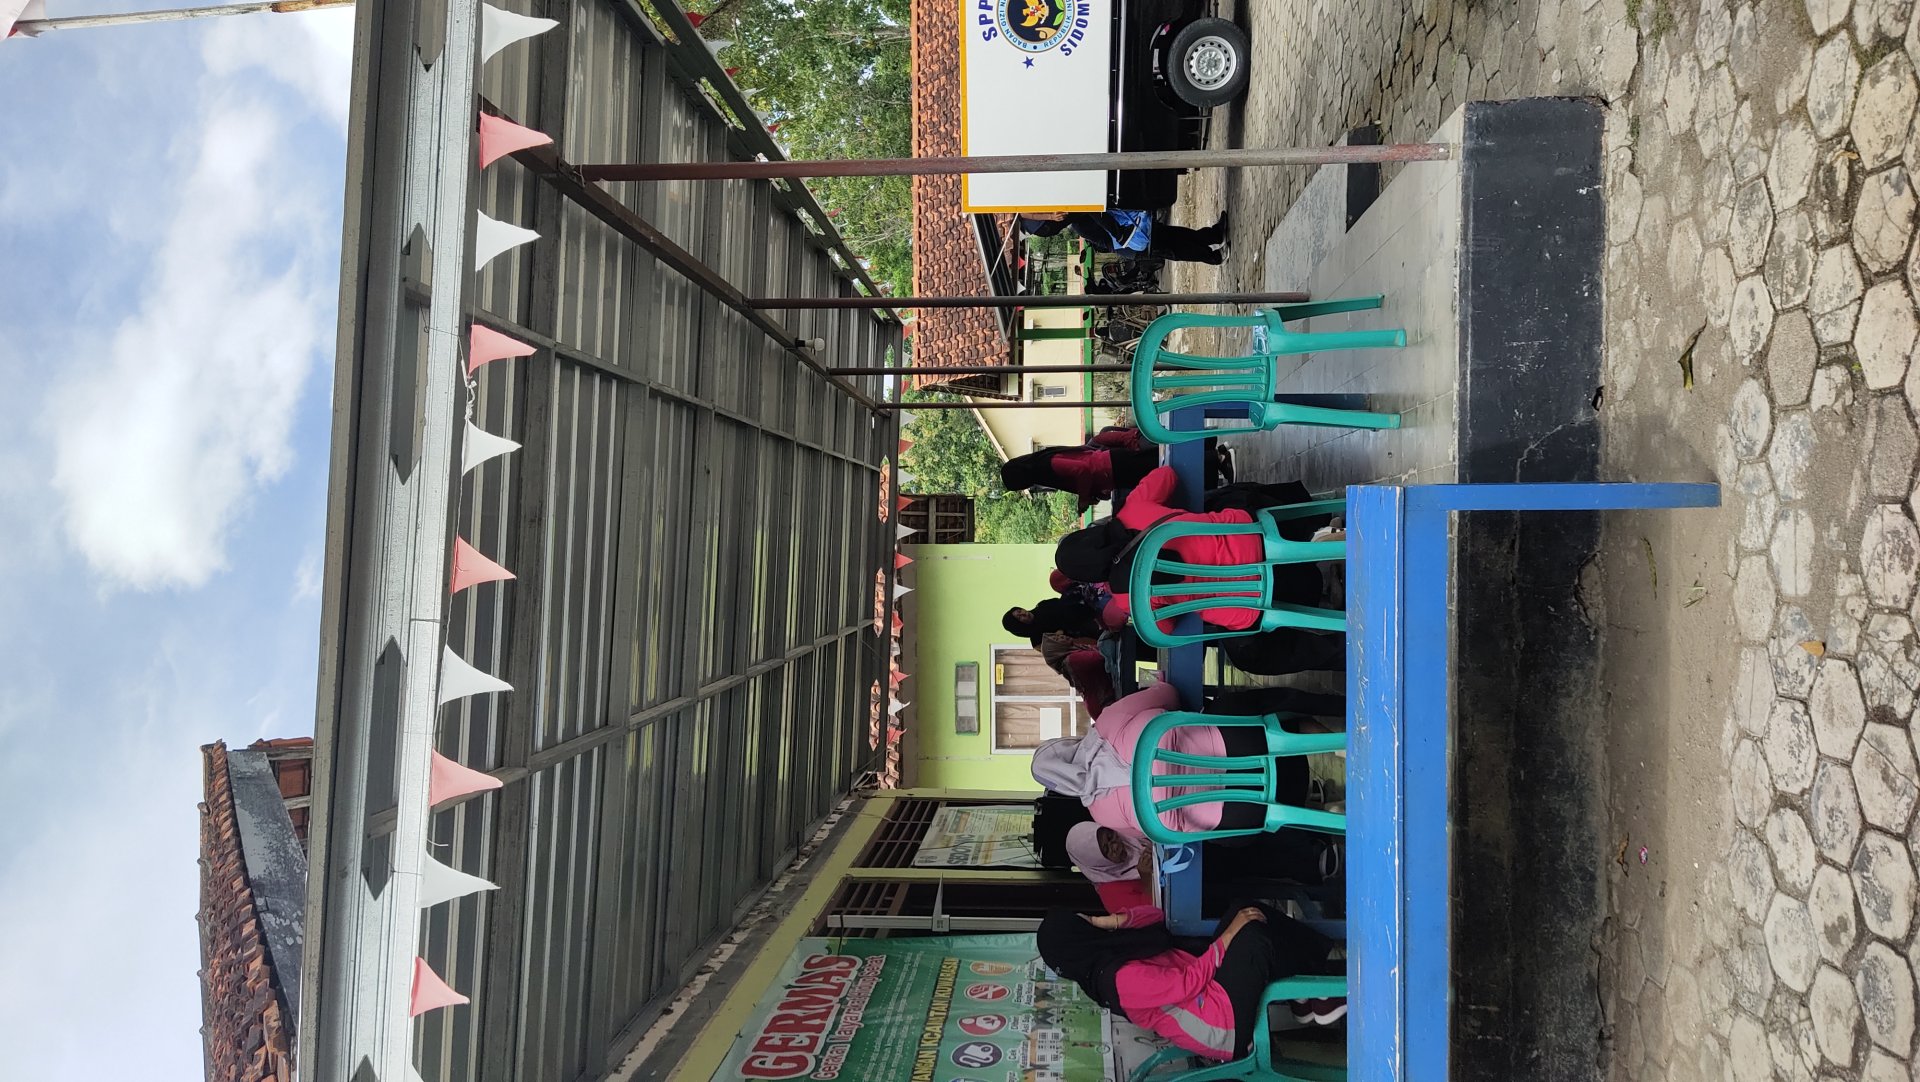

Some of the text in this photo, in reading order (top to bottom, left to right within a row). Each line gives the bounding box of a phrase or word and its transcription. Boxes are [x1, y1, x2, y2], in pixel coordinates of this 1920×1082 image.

[999, 10, 1007, 26] GIZI
[1043, 15, 1072, 48] REPUBLIK
[1004, 28, 1028, 48] BADAN
[740, 954, 858, 1078] GERMAS
[811, 1044, 849, 1079] Gerakan
[859, 955, 885, 977] Sehat
[911, 1050, 937, 1082] ANGAN
[934, 958, 958, 998] KUWARASAN
[1008, 1049, 1017, 1060] Cek
